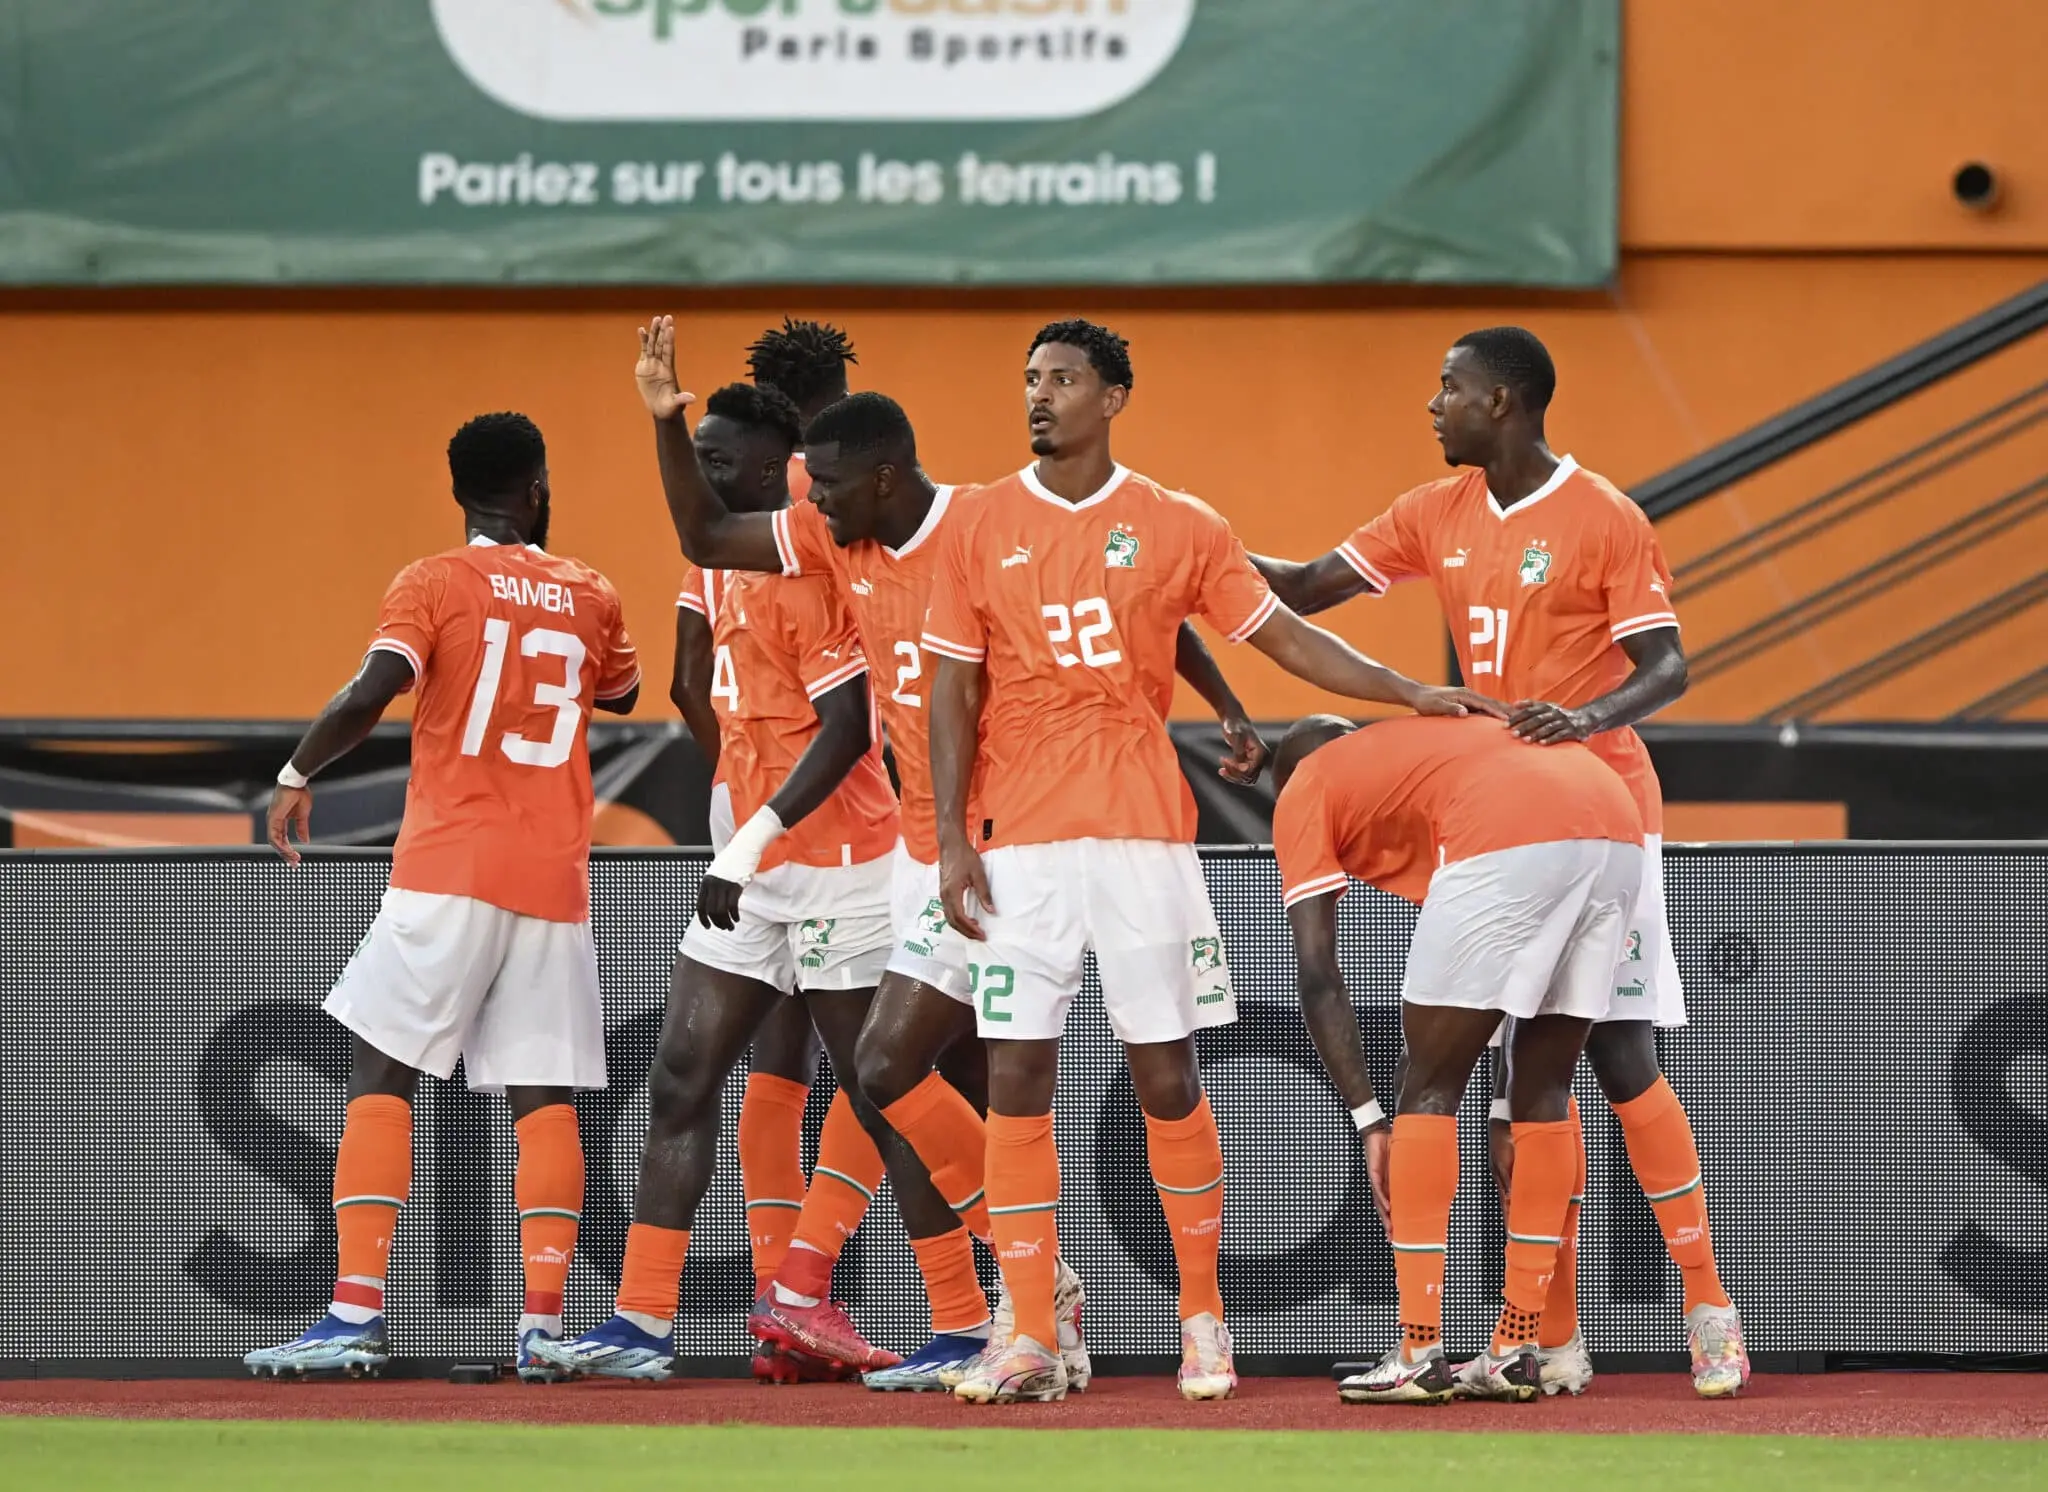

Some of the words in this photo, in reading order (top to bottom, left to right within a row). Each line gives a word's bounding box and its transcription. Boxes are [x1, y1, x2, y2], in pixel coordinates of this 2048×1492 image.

[418, 152, 599, 205] Pariez
[611, 160, 704, 205] sur
[716, 151, 845, 204] tous
[857, 152, 945, 205] les
[956, 151, 1184, 206] terrains
[489, 573, 575, 616] BAMBA
[1041, 596, 1122, 668] 22
[1468, 605, 1509, 677] 21
[461, 617, 587, 769] 13
[710, 644, 740, 713] 4
[1196, 992, 1225, 1006] PUMA
[1616, 985, 1644, 997] PUMA
